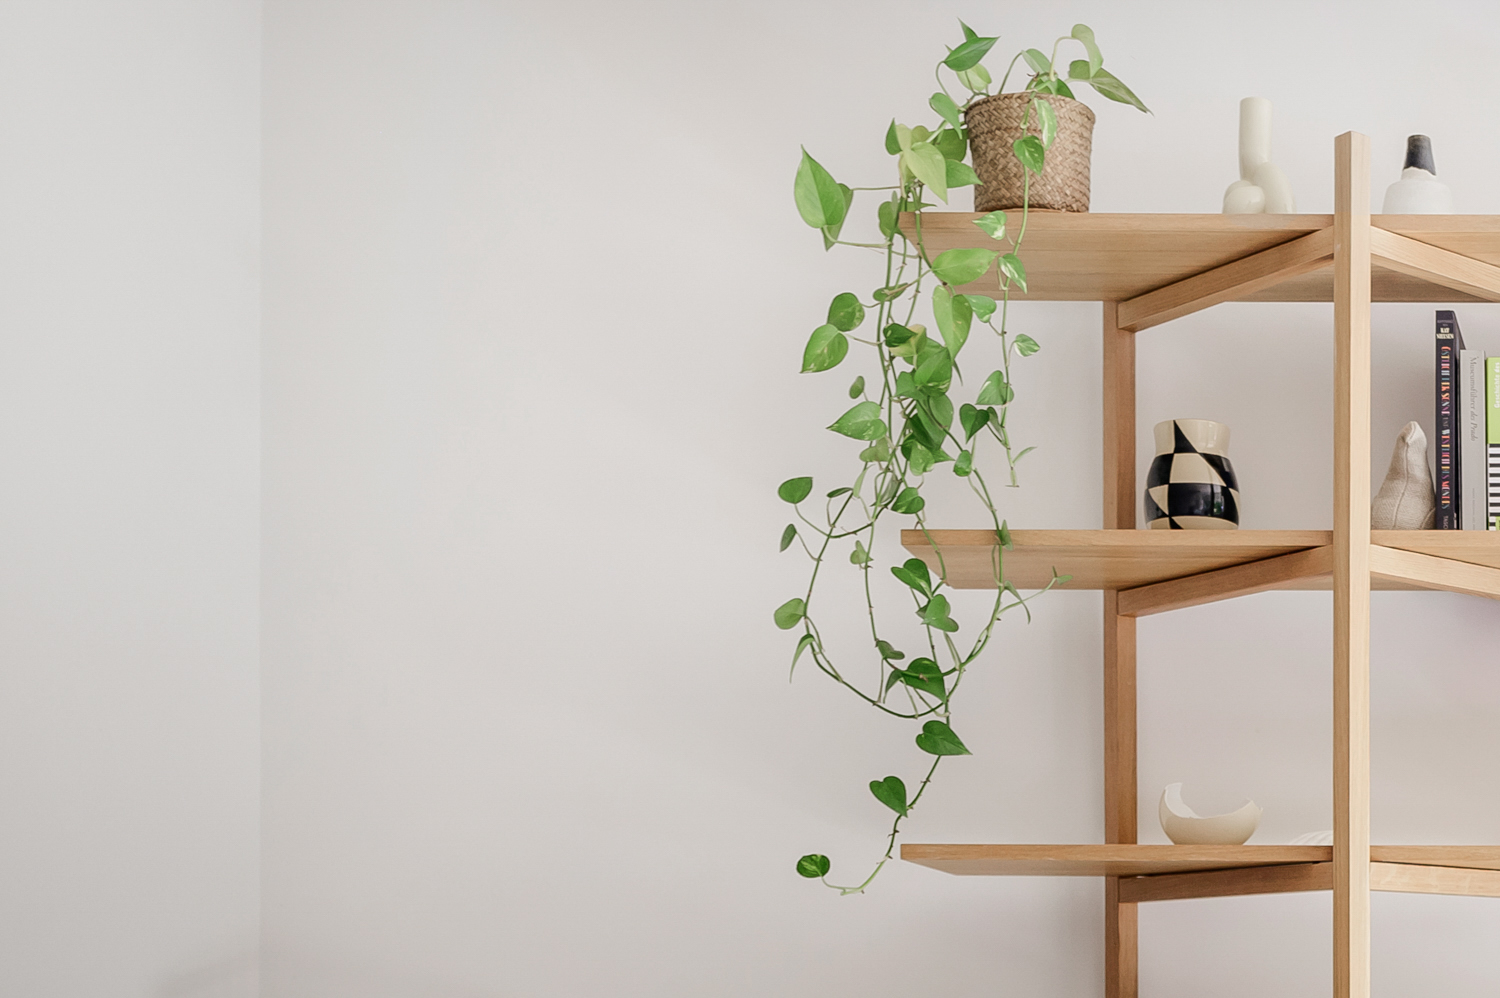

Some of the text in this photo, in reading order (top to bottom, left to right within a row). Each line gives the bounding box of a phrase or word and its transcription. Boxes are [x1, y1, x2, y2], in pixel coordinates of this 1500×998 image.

[1469, 356, 1479, 442] Museumsführer des Prado
